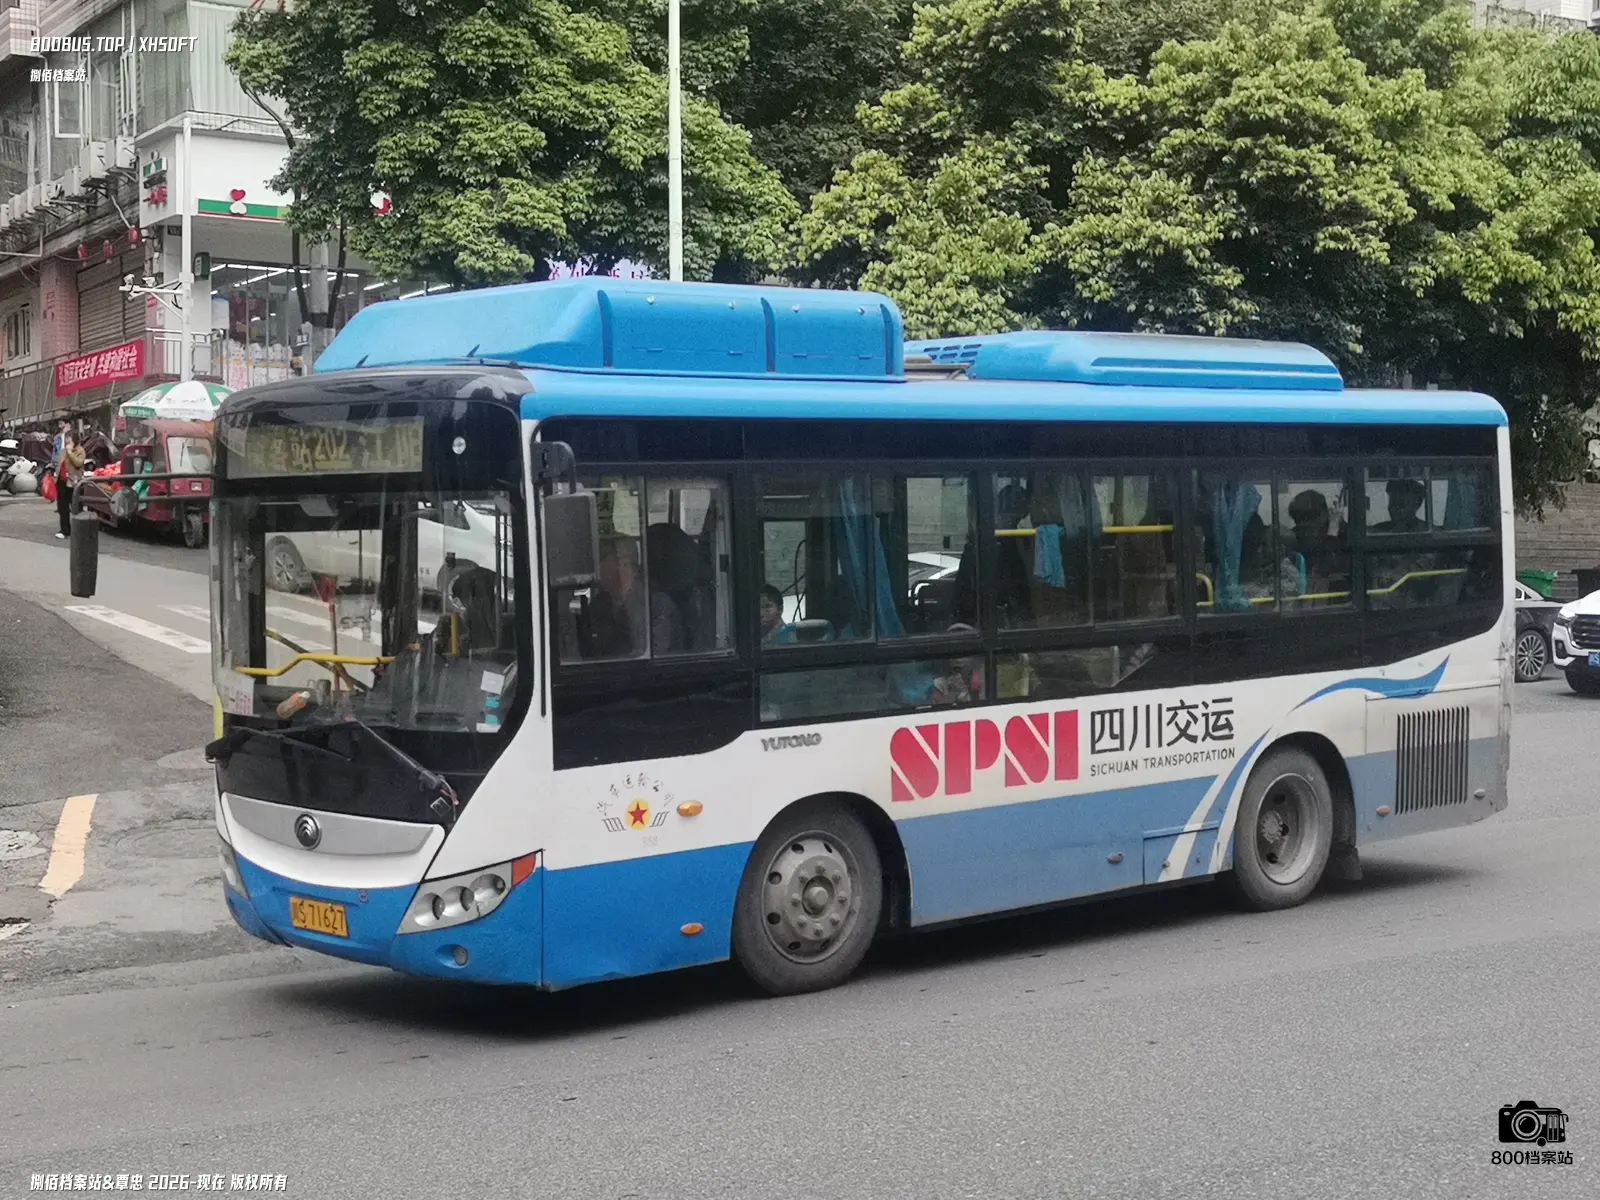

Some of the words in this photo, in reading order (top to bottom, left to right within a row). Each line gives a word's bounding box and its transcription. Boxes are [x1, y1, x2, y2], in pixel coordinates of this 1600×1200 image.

[761, 733, 822, 752] YUTONG
[1089, 697, 1235, 755] 四川交运
[889, 709, 1079, 803] SPSI
[1089, 758, 1139, 777] SICHUAN
[1142, 747, 1235, 769] TRANSPORTATION
